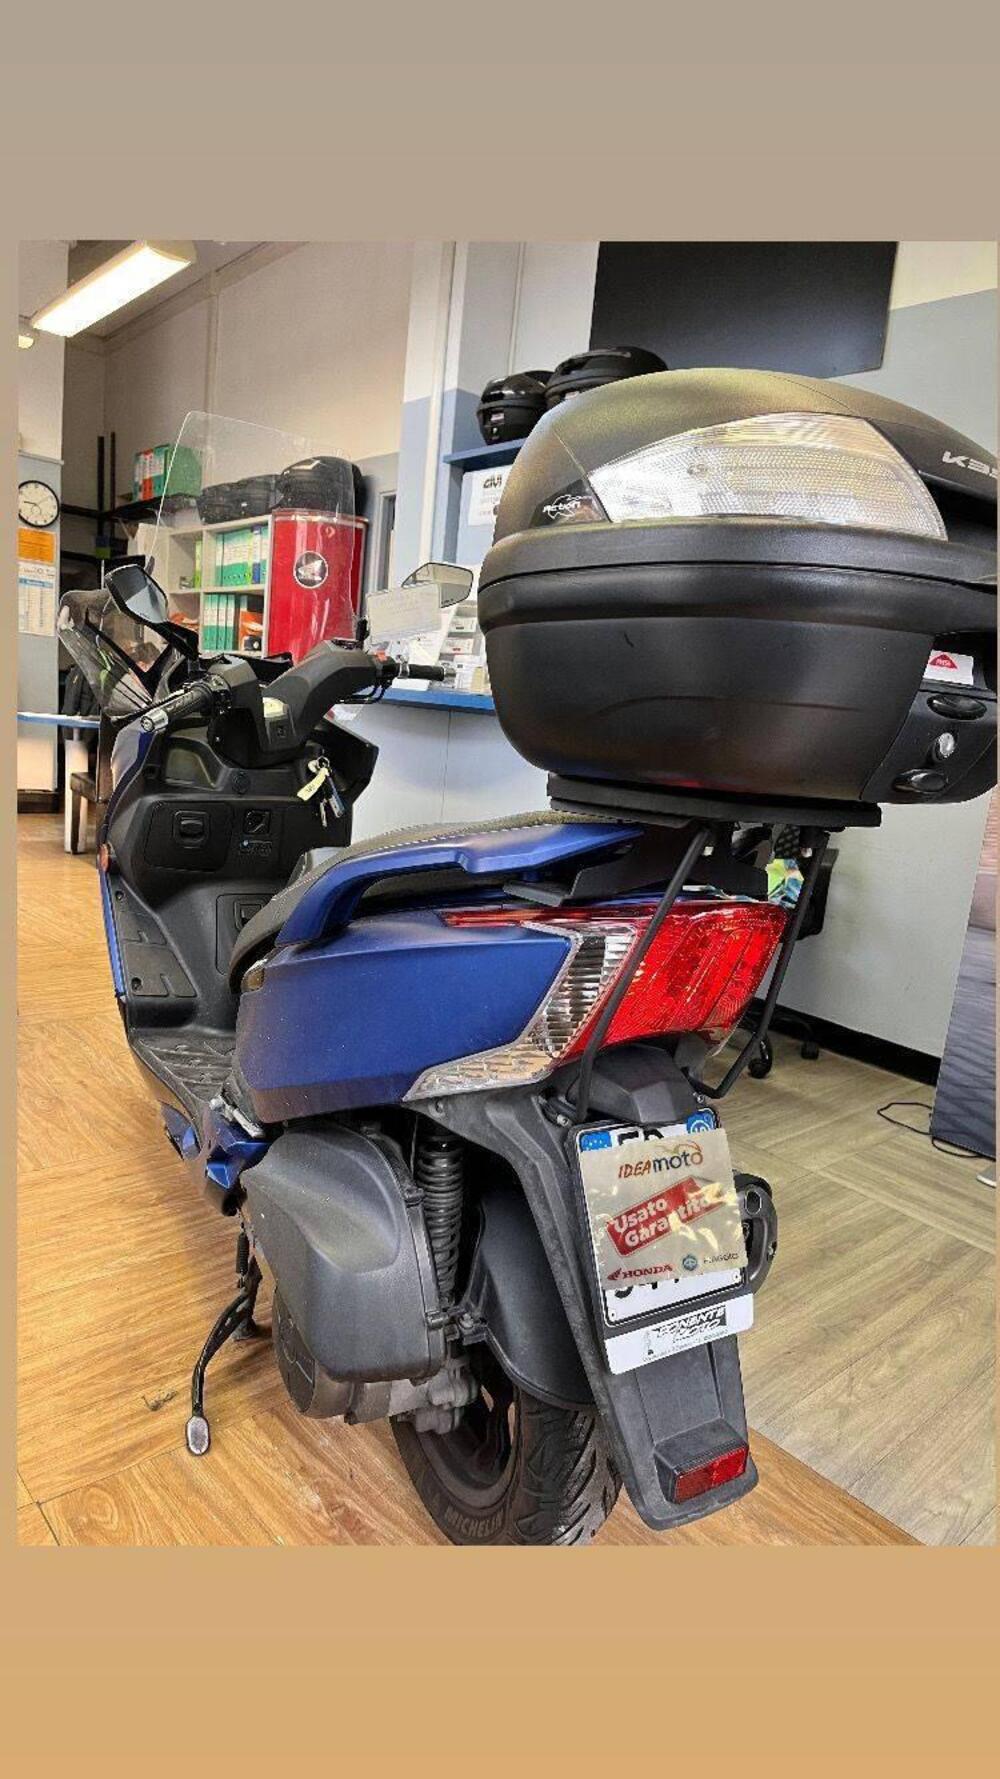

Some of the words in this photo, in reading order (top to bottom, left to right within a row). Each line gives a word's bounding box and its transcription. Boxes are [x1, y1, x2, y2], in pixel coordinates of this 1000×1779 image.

[613, 1199, 667, 1233] Usato
[625, 1194, 711, 1247] Garatito
[622, 1264, 673, 1279] HONDA
[445, 1505, 504, 1538] MICHELIN
